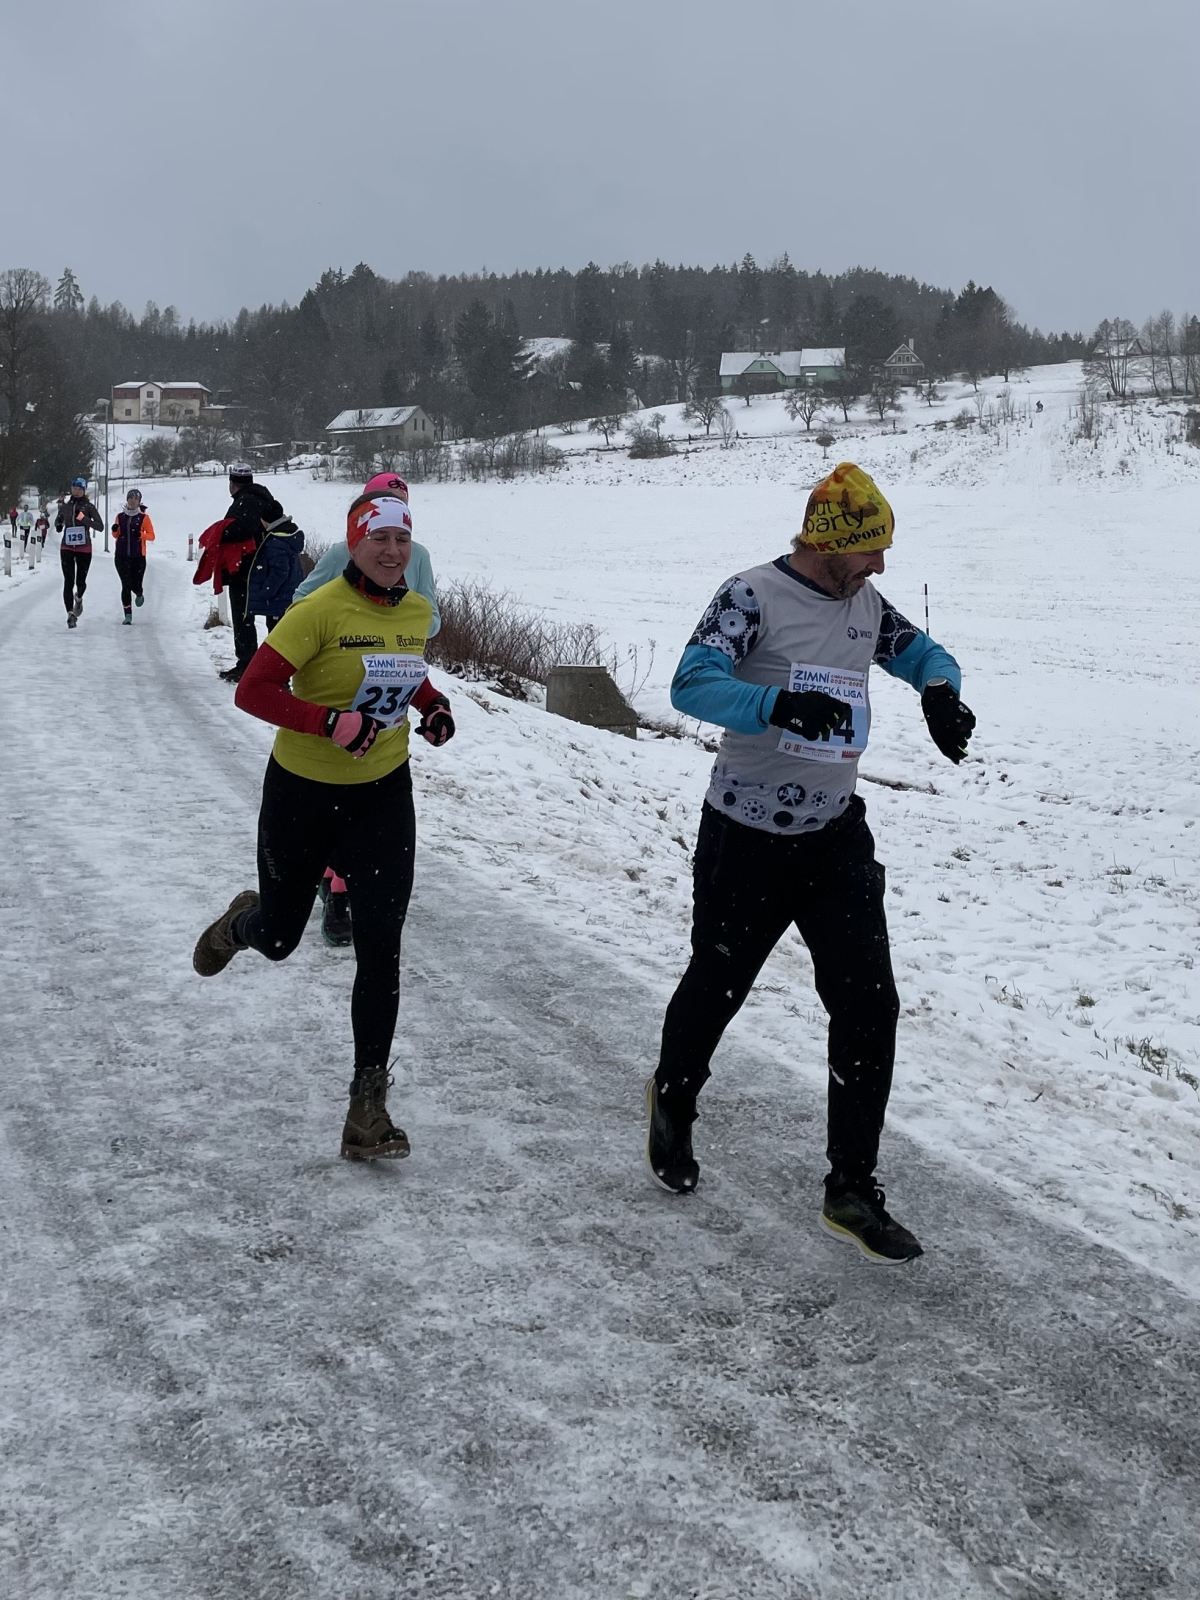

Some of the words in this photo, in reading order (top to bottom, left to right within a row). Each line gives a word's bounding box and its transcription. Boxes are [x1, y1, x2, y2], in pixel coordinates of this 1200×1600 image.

[805, 506, 864, 536] party
[67, 533, 83, 542] 129
[835, 525, 886, 549] EXPORT
[340, 635, 385, 644] MARATON
[409, 670, 426, 678] LIGA
[794, 670, 831, 684] ZIMNÍ
[356, 686, 418, 715] 234
[843, 689, 864, 700] LIGA
